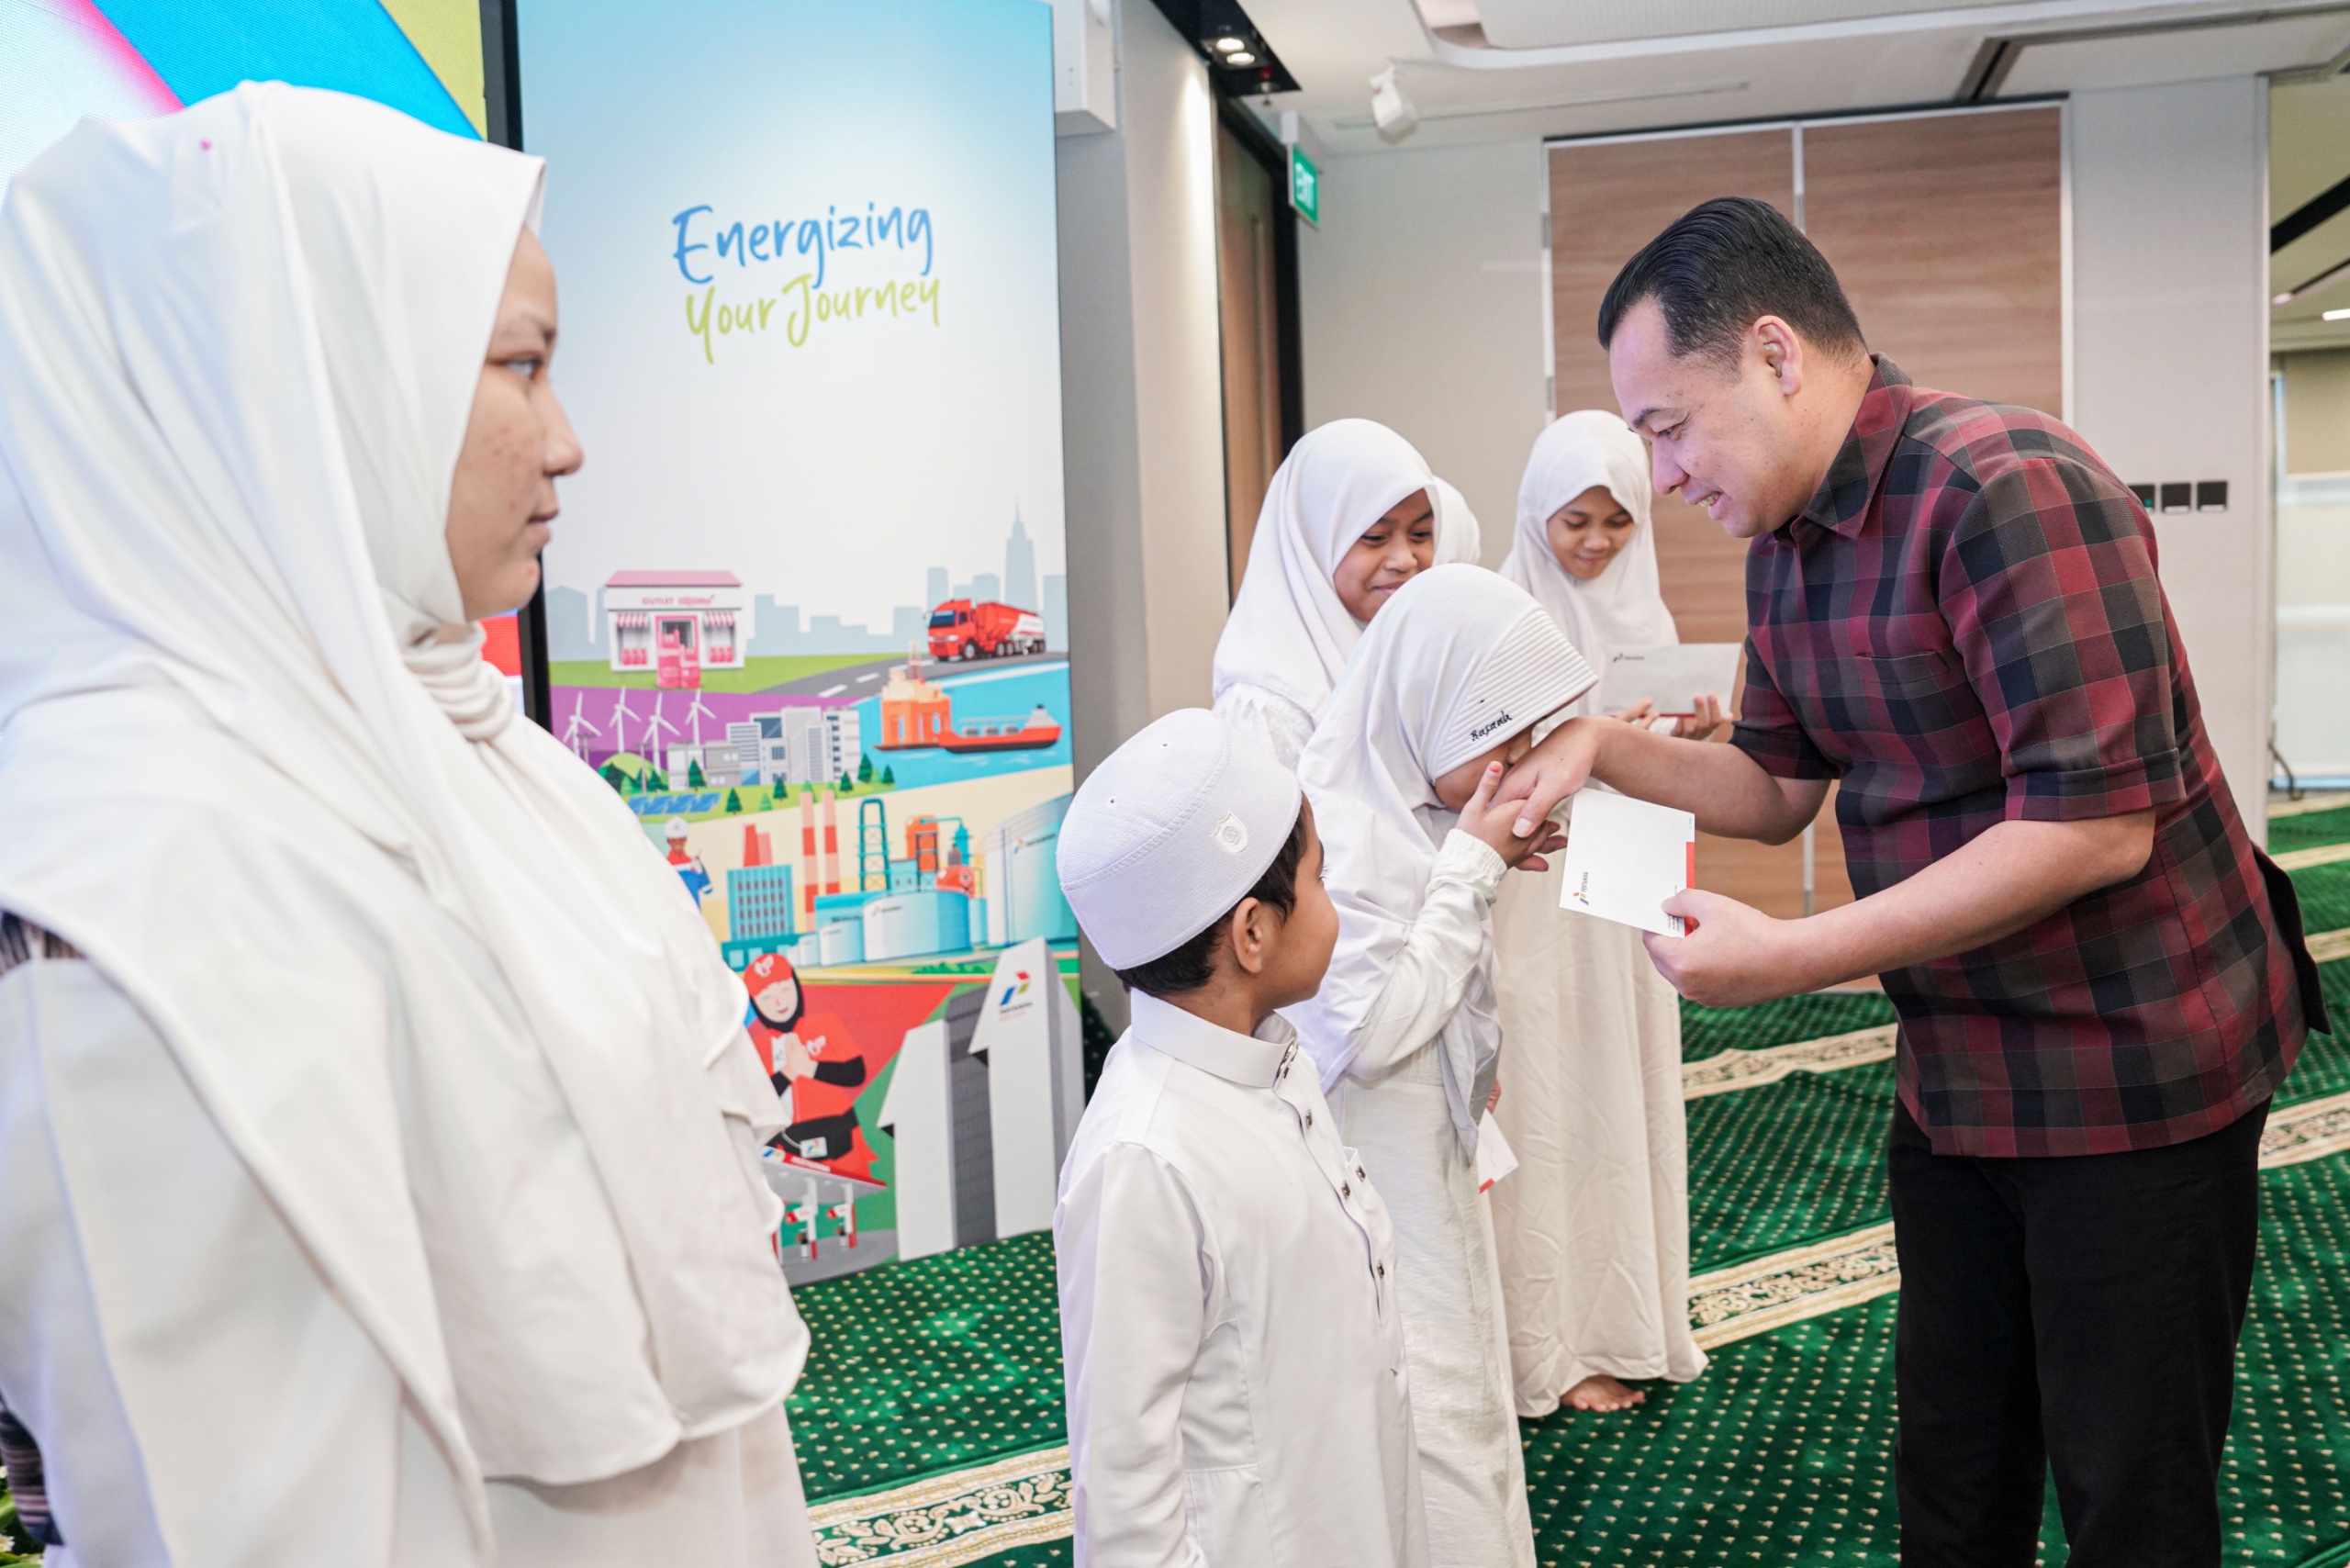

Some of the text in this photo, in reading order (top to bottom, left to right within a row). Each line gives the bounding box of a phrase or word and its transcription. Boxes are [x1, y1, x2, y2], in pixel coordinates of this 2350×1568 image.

[672, 201, 933, 290] Energizing
[686, 273, 940, 365] Your Journey
